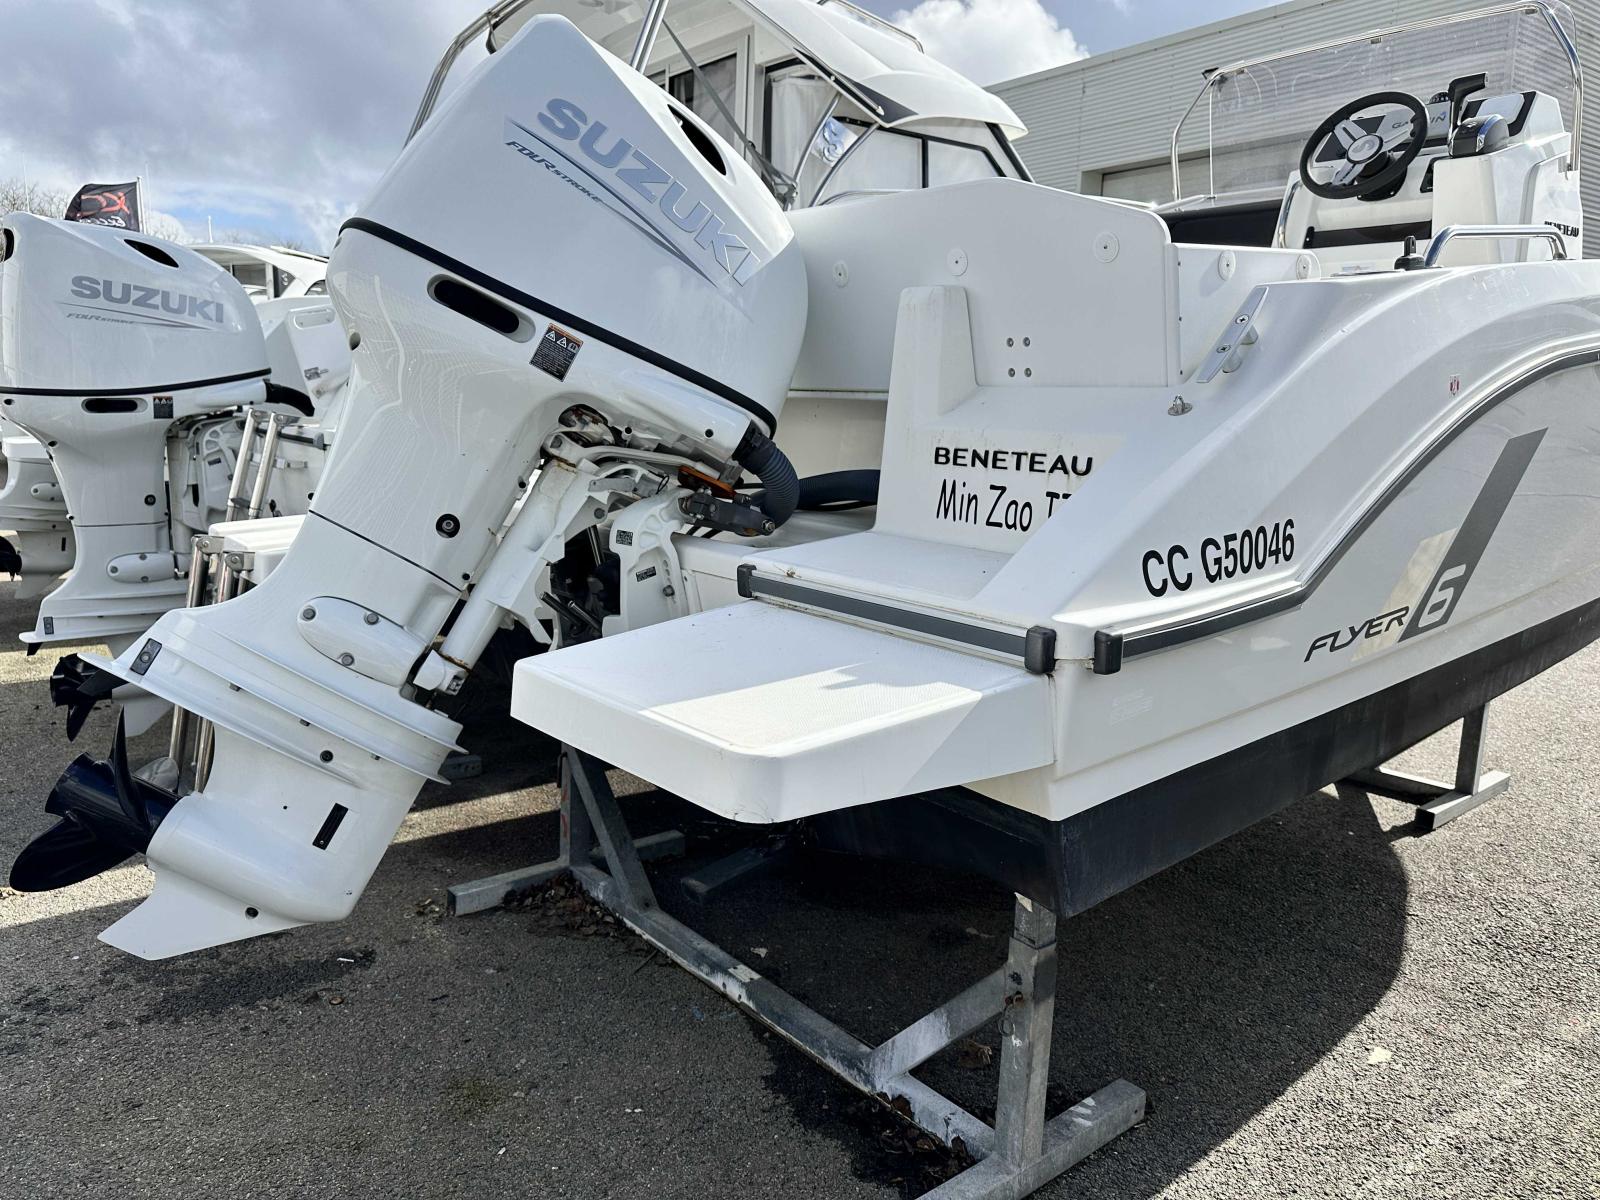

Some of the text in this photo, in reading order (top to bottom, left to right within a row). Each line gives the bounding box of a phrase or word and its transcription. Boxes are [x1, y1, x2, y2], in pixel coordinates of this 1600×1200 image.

[537, 98, 760, 287] SUZUKI
[70, 275, 224, 324] SUZUKI
[934, 446, 1093, 476] BENETEAU
[936, 478, 1073, 532] Min Zao T
[1142, 518, 1295, 598] CC G50046
[1303, 563, 1467, 663] FLYER 6
